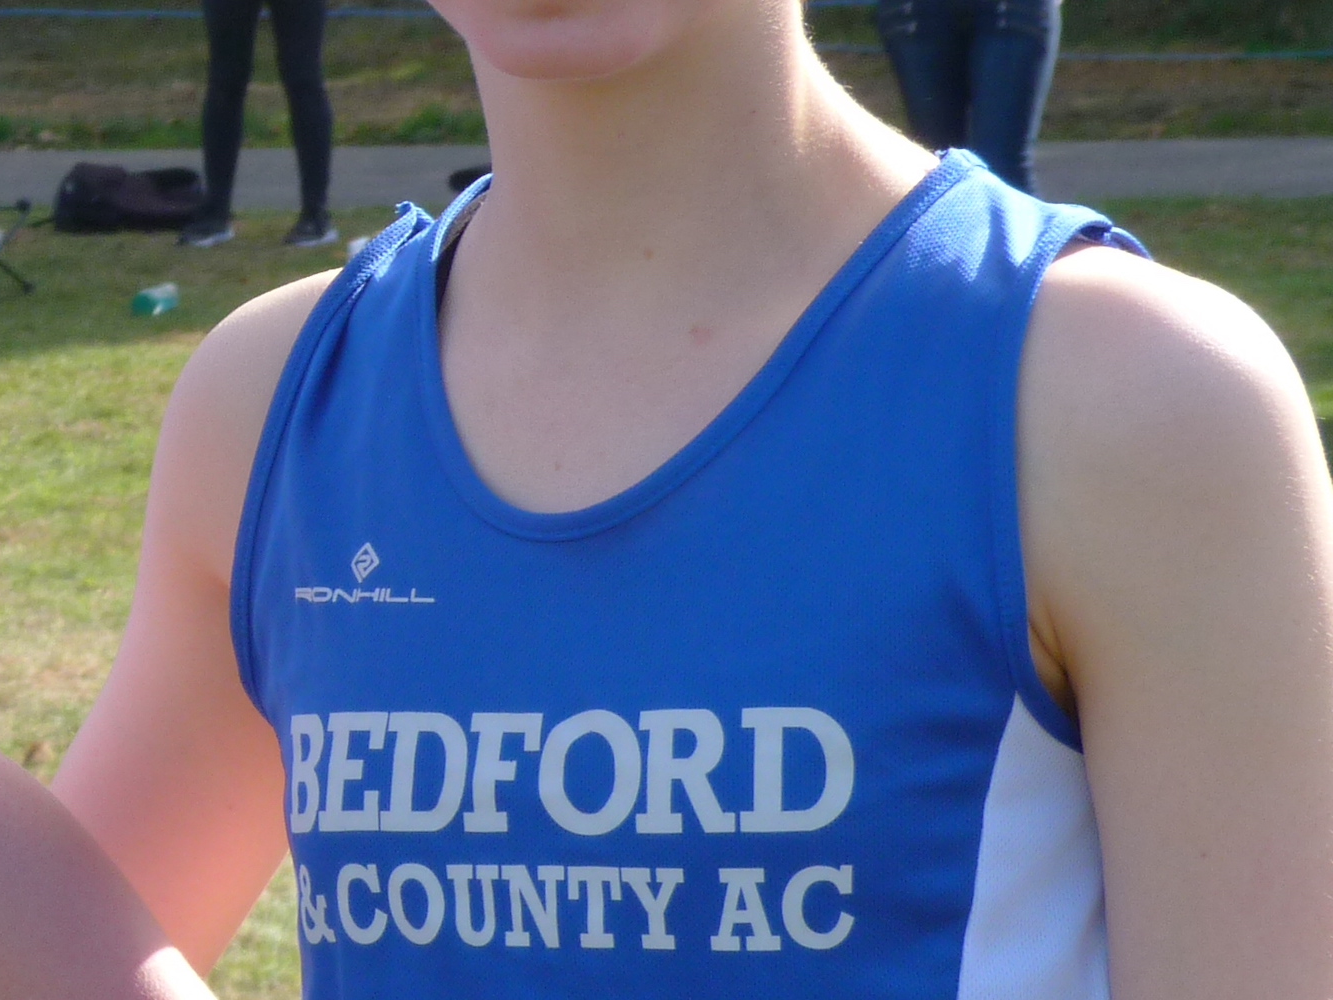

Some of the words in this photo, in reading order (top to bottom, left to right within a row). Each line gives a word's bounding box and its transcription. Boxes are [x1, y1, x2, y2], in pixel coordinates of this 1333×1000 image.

[295, 586, 435, 604] RONHILL
[290, 707, 855, 835] BEDFORD
[297, 870, 335, 944] &
[336, 863, 685, 950] COUNTY
[710, 864, 855, 952] AC
